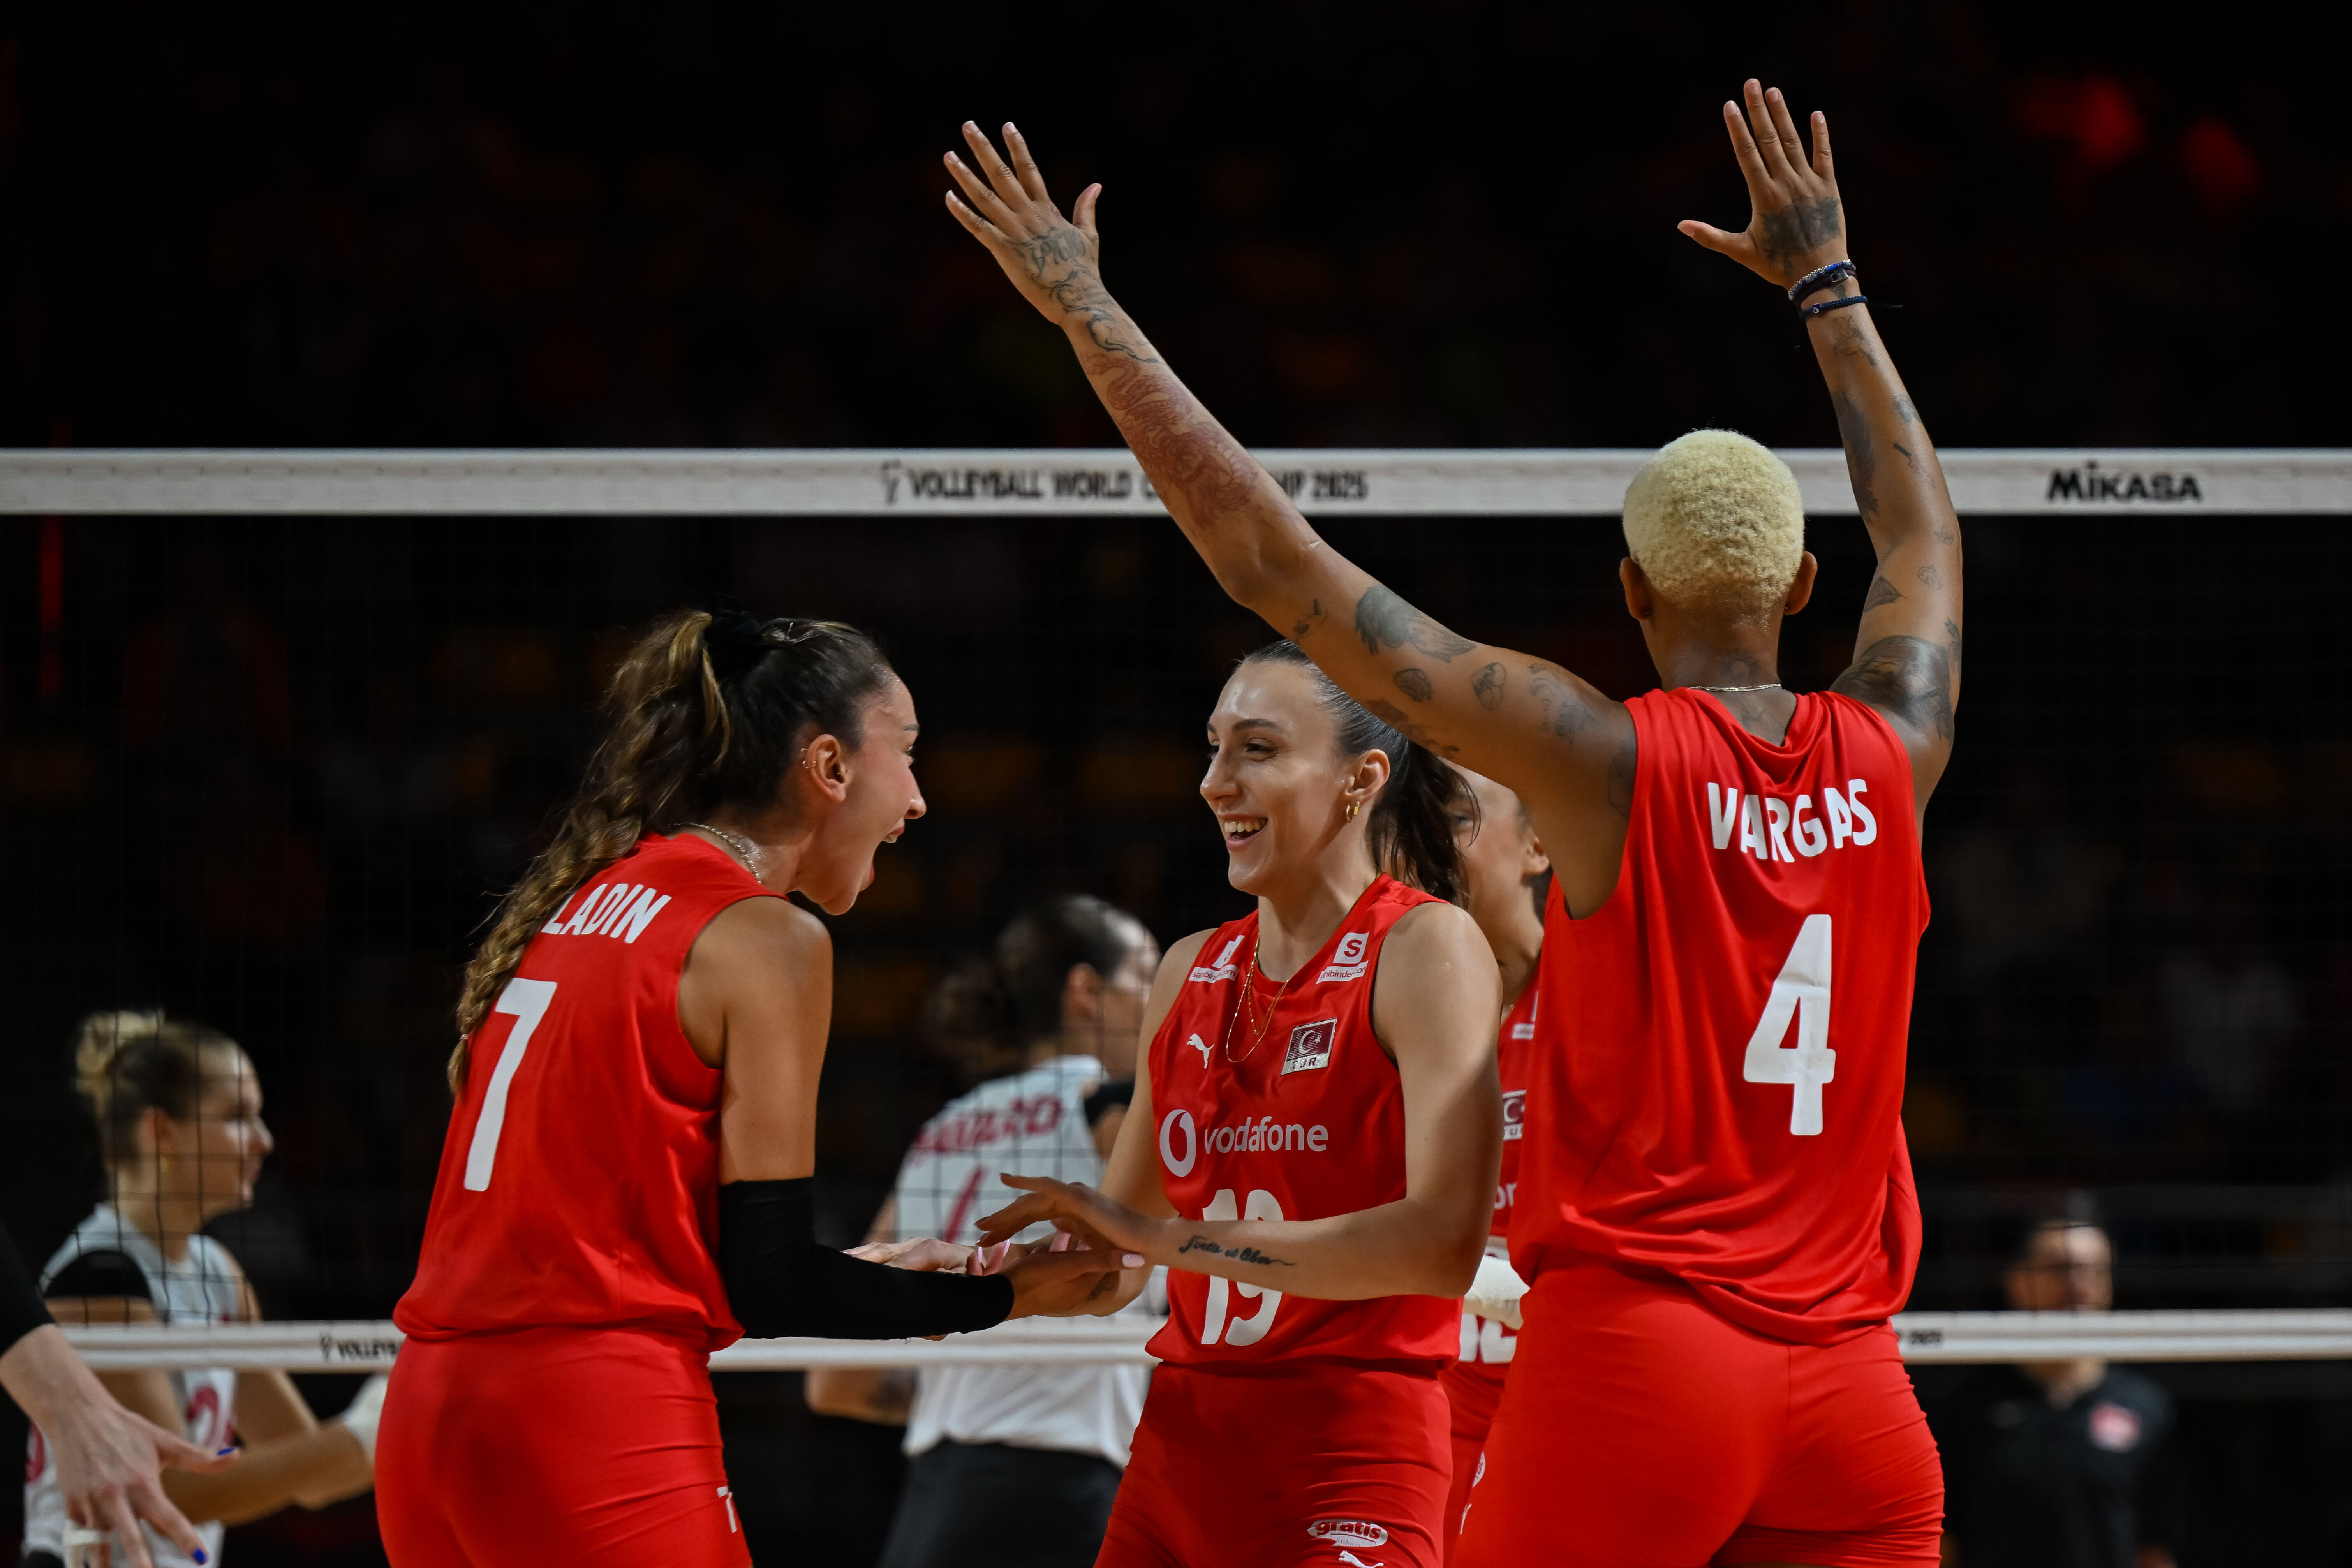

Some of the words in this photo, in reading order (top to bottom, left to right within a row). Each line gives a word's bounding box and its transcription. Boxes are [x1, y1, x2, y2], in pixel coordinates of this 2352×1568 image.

[907, 469, 1045, 497] VOLLEYBALL
[1053, 470, 1131, 498] WORLD
[1707, 779, 1878, 863] VARGAS
[540, 883, 673, 944] LADIN
[1344, 939, 1362, 957] S
[1742, 914, 1837, 1136] 4
[463, 976, 557, 1192] 7
[1204, 1115, 1329, 1154] vodafone
[1201, 1189, 1285, 1346] 19
[1315, 1522, 1381, 1539] gratis
